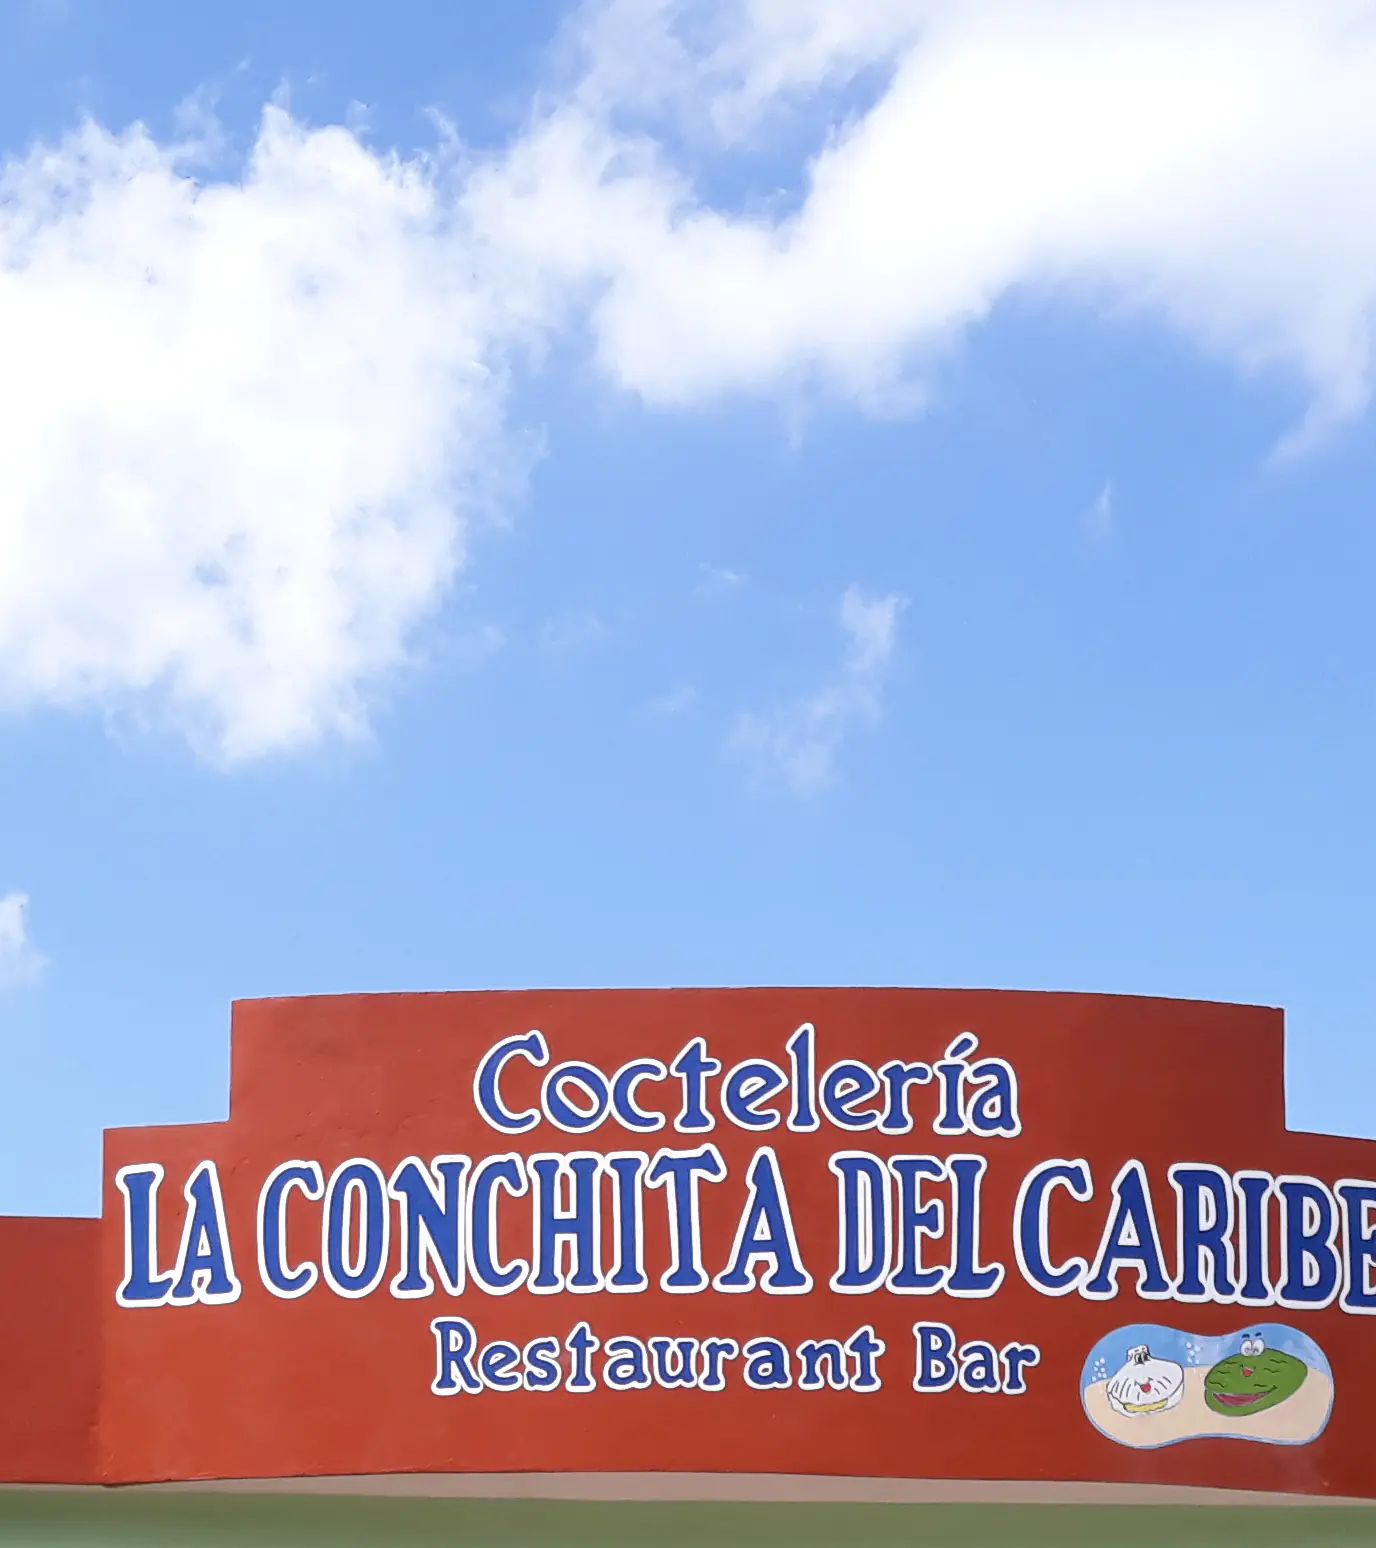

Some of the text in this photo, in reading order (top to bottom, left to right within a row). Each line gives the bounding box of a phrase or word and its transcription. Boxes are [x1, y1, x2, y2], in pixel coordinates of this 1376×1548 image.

[473, 1023, 1022, 1138] Coctelería
[115, 1159, 241, 1308] LA
[257, 1143, 813, 1299] CONCHITA
[828, 1150, 1005, 1298] DEL
[430, 1316, 1040, 1396] Restaurant Bar
